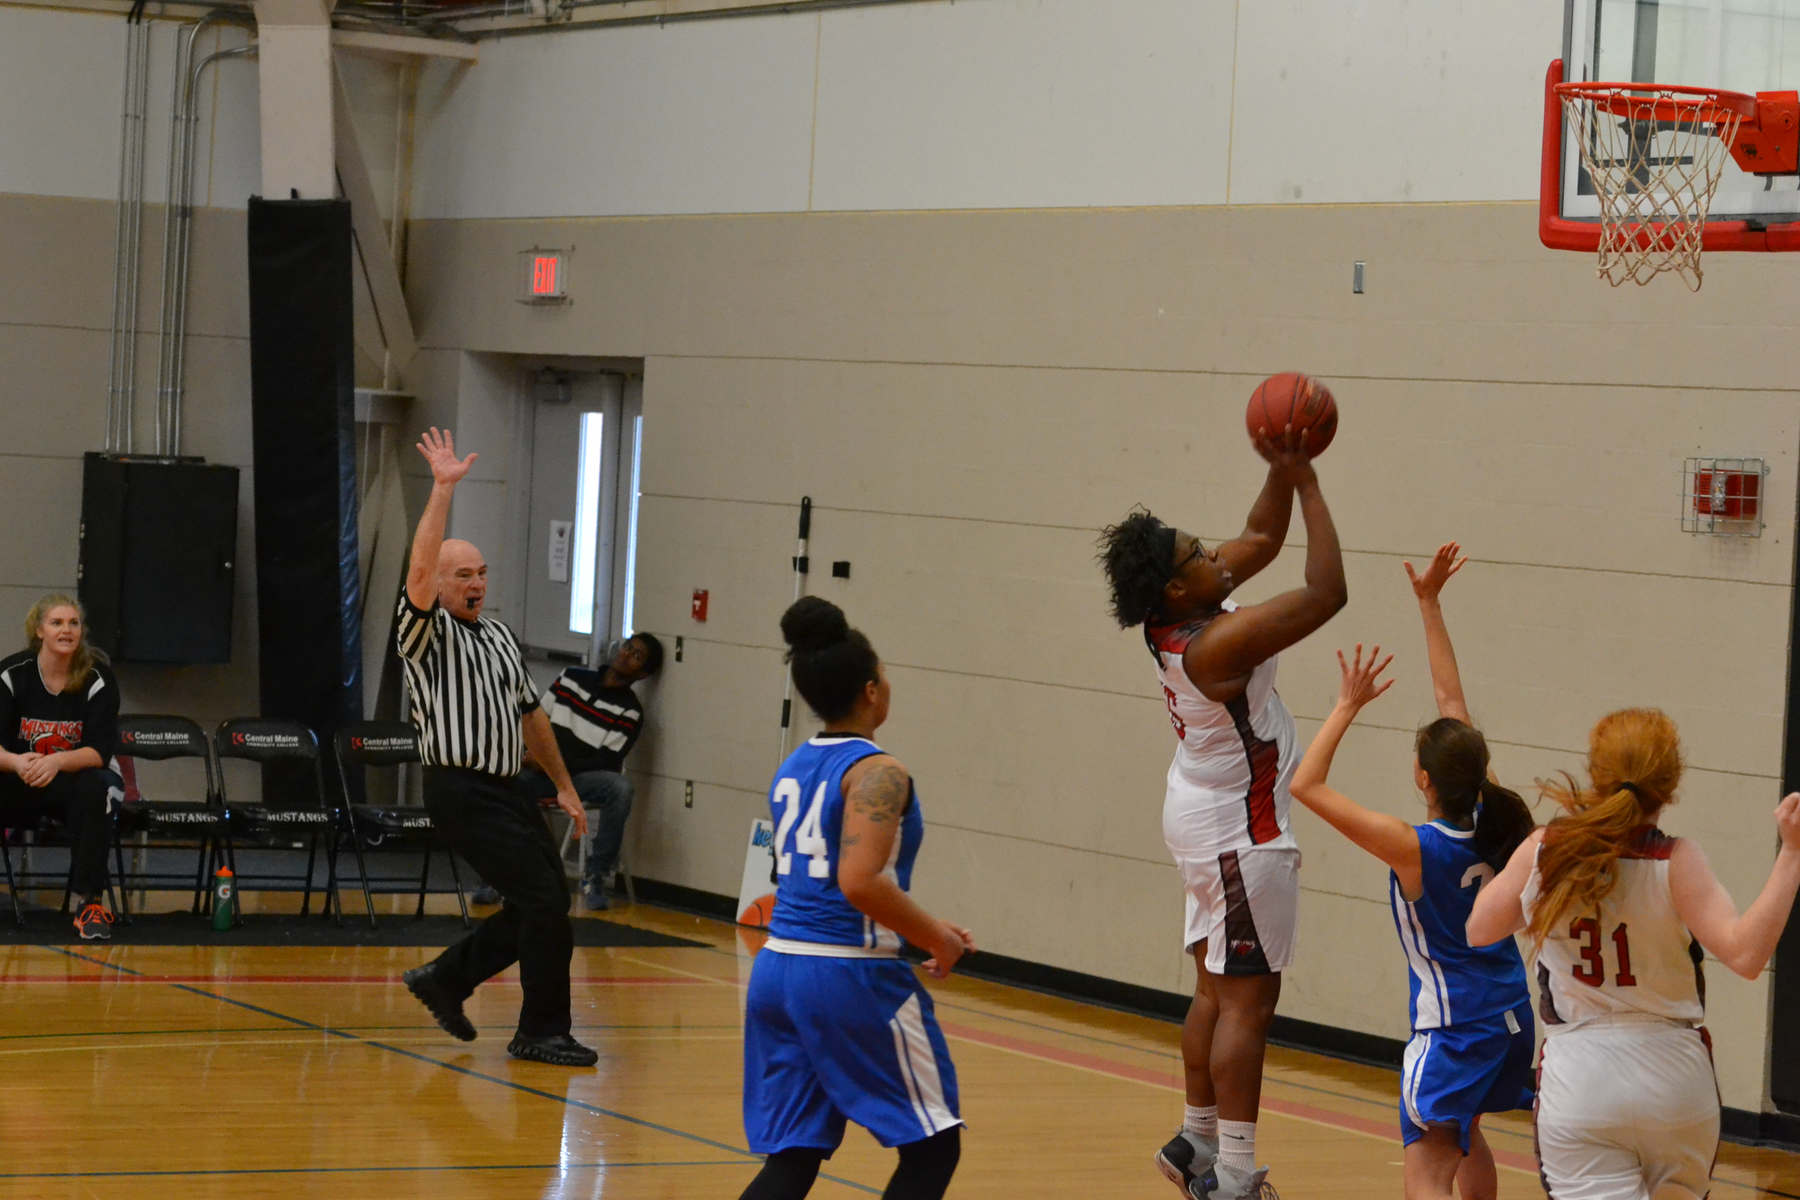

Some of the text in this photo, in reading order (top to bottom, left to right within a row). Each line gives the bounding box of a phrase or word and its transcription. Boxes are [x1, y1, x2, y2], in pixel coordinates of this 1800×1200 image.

[533, 257, 557, 293] EXIT
[18, 717, 83, 743] MUSTANGS
[134, 731, 189, 740] Central Maine
[245, 733, 299, 743] Central Maine
[363, 737, 413, 746] Central Maine
[156, 812, 218, 823] MUSTANGS
[266, 812, 328, 823] MUSTANGS
[402, 817, 435, 828] MUST
[773, 777, 830, 879] 24
[218, 884, 231, 899] G
[1569, 916, 1637, 987] 31
